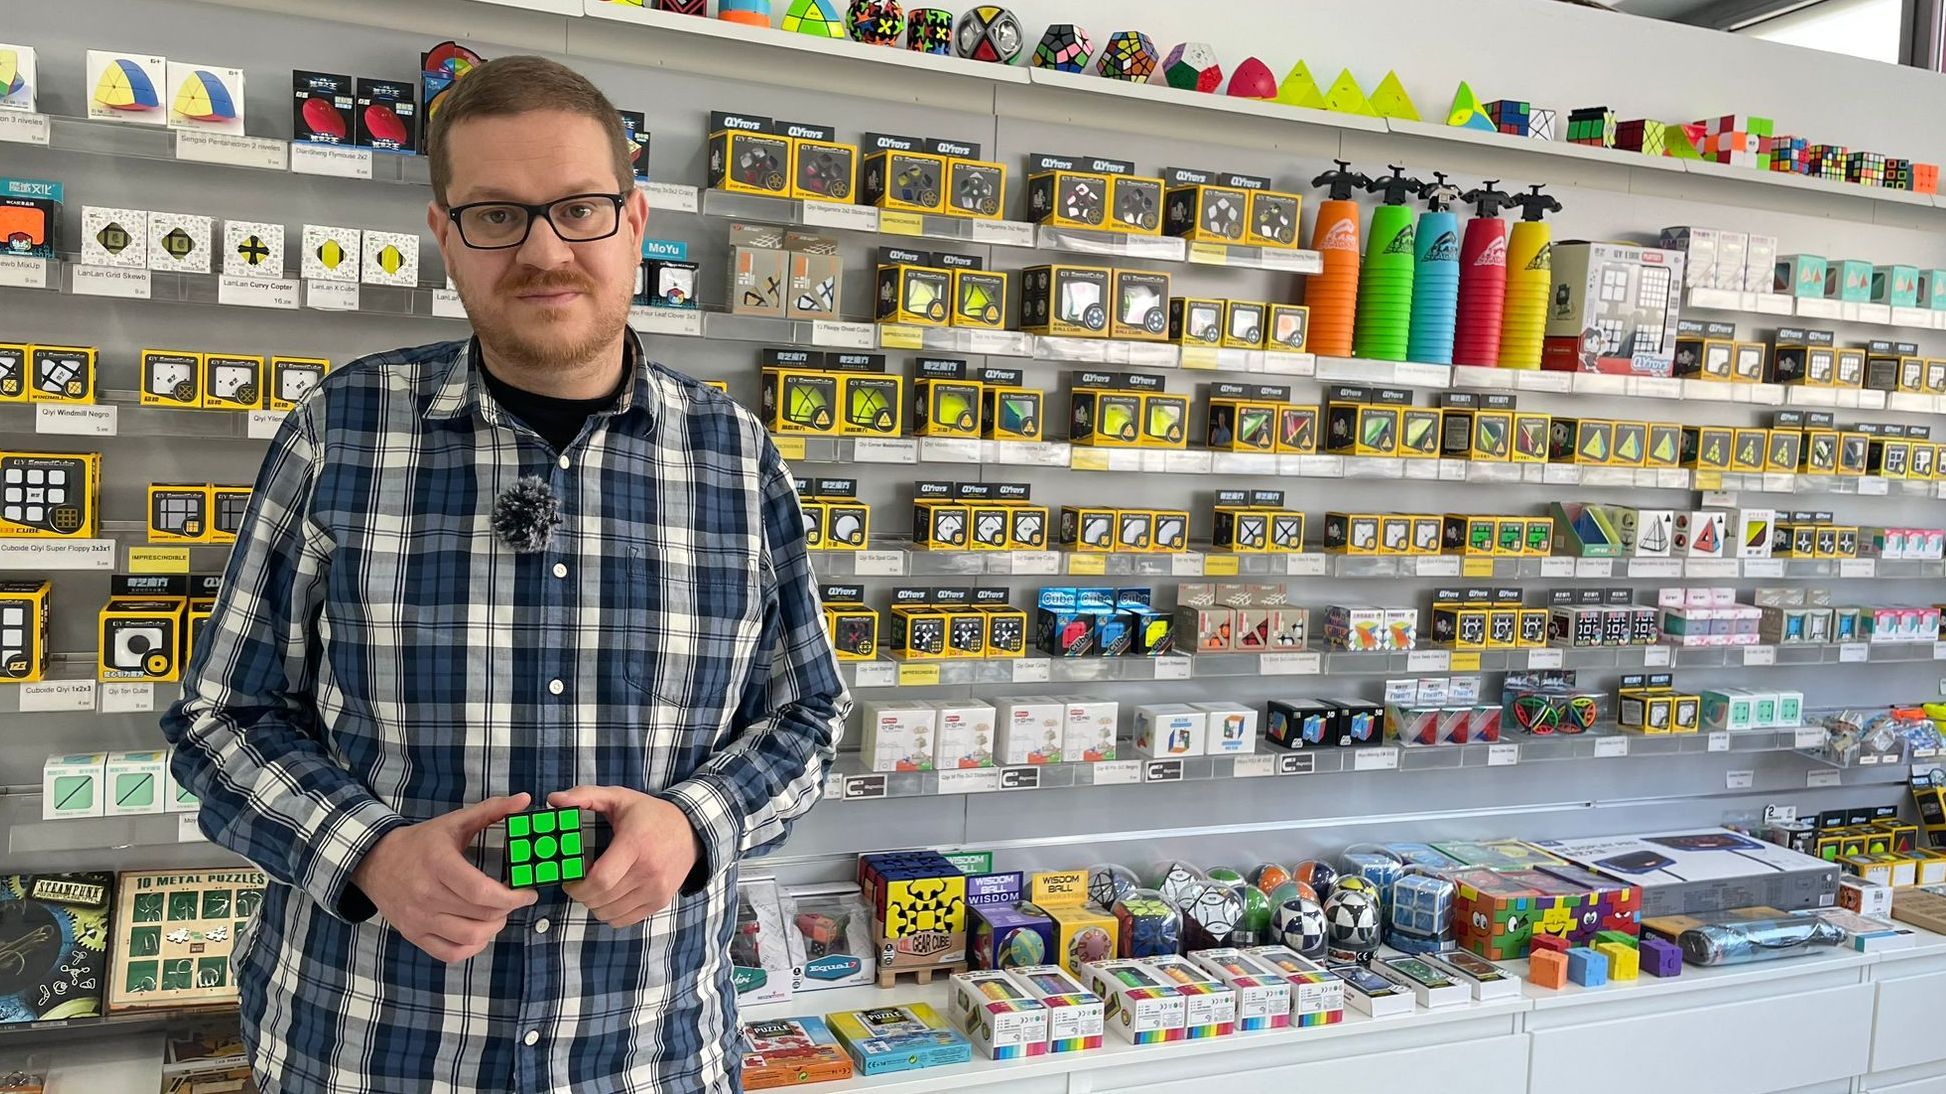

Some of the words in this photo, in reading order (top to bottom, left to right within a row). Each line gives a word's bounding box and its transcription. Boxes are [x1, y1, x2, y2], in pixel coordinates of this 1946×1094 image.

[18, 116, 43, 126] niveles
[648, 242, 679, 254] MoYu
[18, 262, 40, 270] MixUp
[78, 270, 104, 279] LanLan
[122, 272, 146, 281] Skewb
[224, 280, 248, 288] LanLan
[250, 282, 270, 290] Curvy
[270, 282, 292, 292] Copter
[312, 282, 333, 290] LanLan
[42, 408, 56, 418] Qiyi
[57, 410, 87, 418] Windmill
[88, 411, 109, 419] Negro
[254, 414, 266, 422] Qiyi
[30, 544, 43, 552] Qiyi
[44, 545, 66, 553] Super
[67, 545, 90, 553] Floppy
[1043, 592, 1074, 605] Cube
[9, 662, 27, 671] 123
[137, 878, 150, 889] 10
[157, 875, 201, 886] METAL
[208, 873, 265, 885] PUZZLES
[974, 875, 1014, 884] WISDOM
[1043, 875, 1079, 885] WISDOM
[39, 882, 102, 898] STEAMPUNK
[981, 885, 1007, 893] BALL
[1048, 884, 1073, 893] BALL
[969, 892, 1020, 904] WISDOM
[912, 936, 930, 952] GEAR
[932, 935, 950, 950] CUBE
[734, 974, 753, 984] dini
[867, 1010, 901, 1021] PUZZLE
[754, 1024, 789, 1034] PUZZLE
